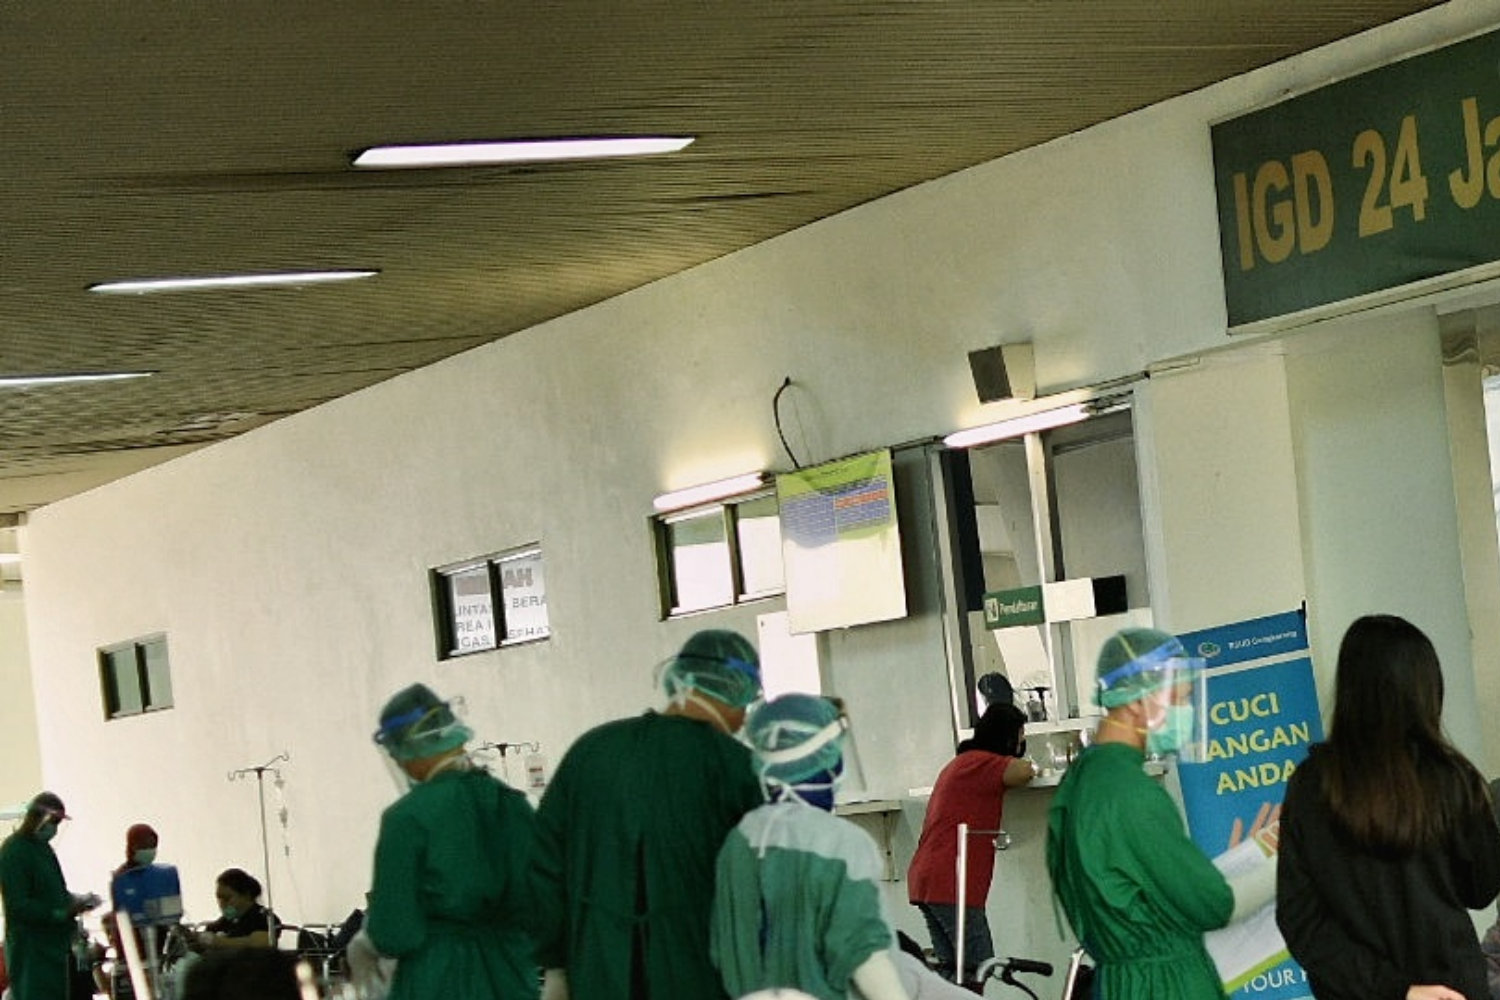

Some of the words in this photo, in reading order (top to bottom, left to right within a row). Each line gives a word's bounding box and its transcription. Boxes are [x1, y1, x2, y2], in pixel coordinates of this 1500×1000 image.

[1233, 150, 1334, 271] IGD
[1353, 115, 1429, 238] 24
[1210, 691, 1280, 726] CUCI
